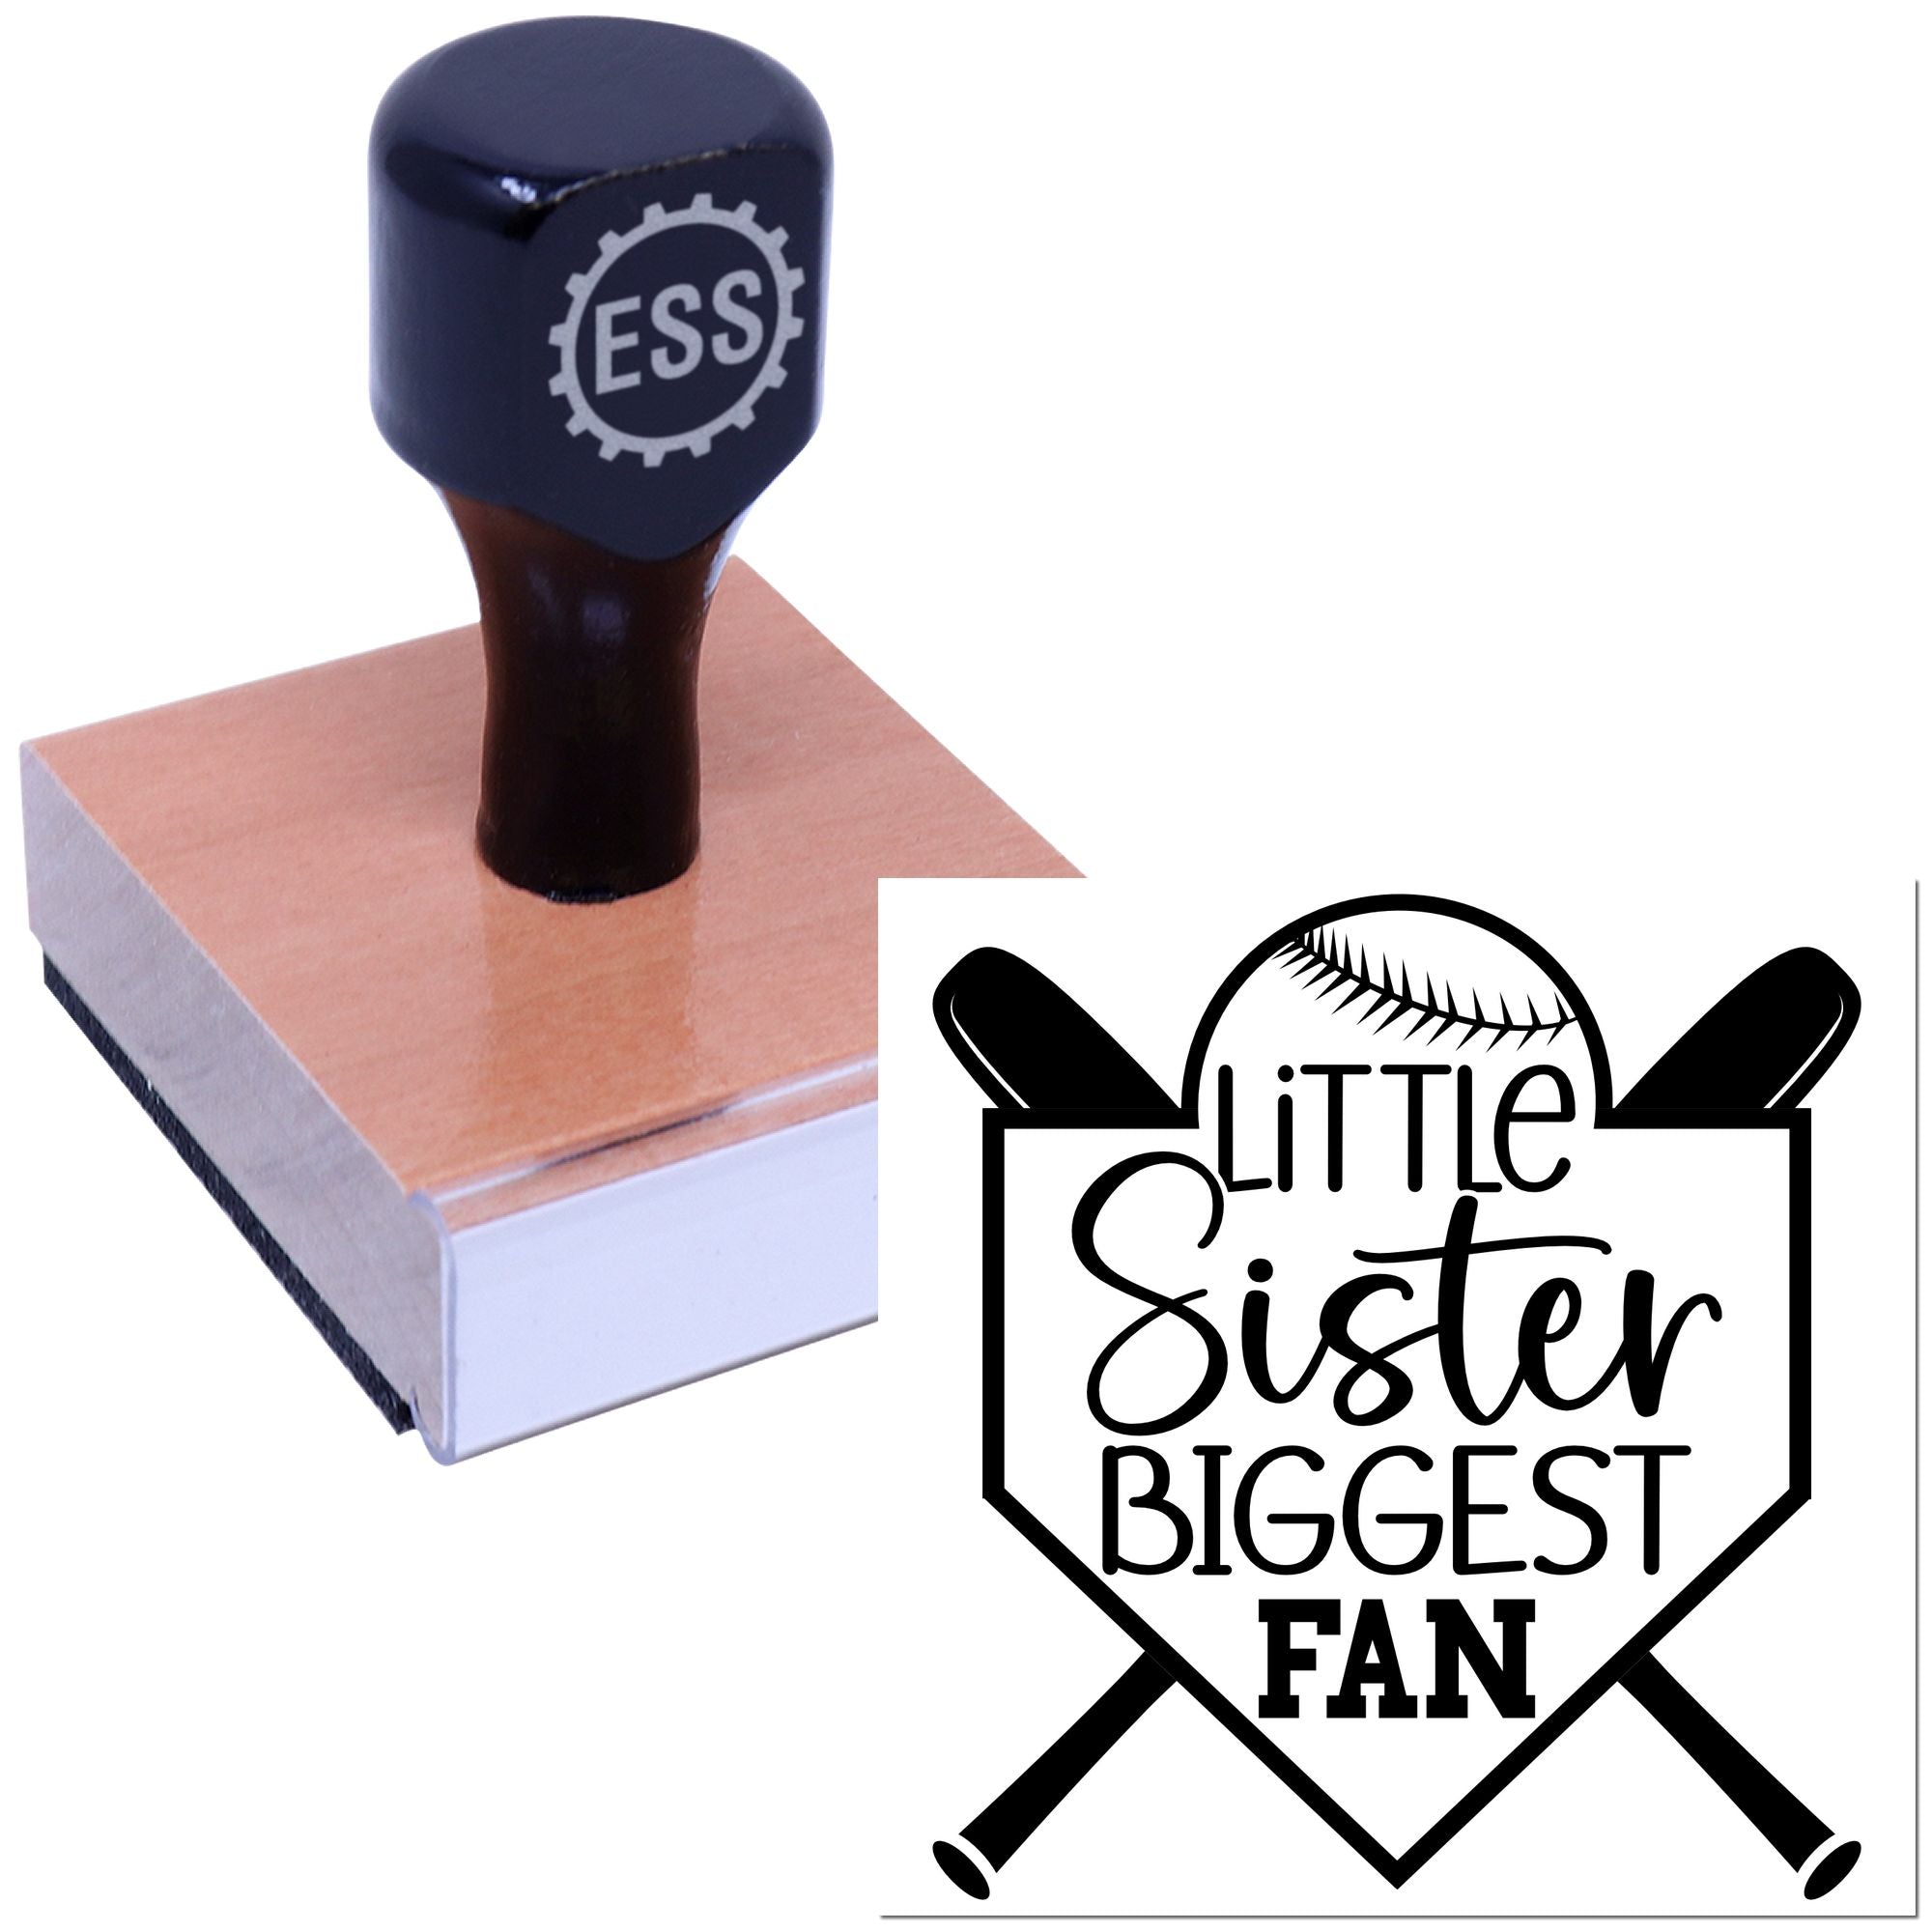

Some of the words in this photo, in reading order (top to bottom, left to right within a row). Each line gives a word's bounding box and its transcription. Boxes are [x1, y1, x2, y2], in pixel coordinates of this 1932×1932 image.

[595, 270, 763, 395] ESS
[1072, 1151, 1722, 1435] Sister
[1102, 1445, 1691, 1575] BIGGEST
[1259, 1599, 1535, 1718] FAN
